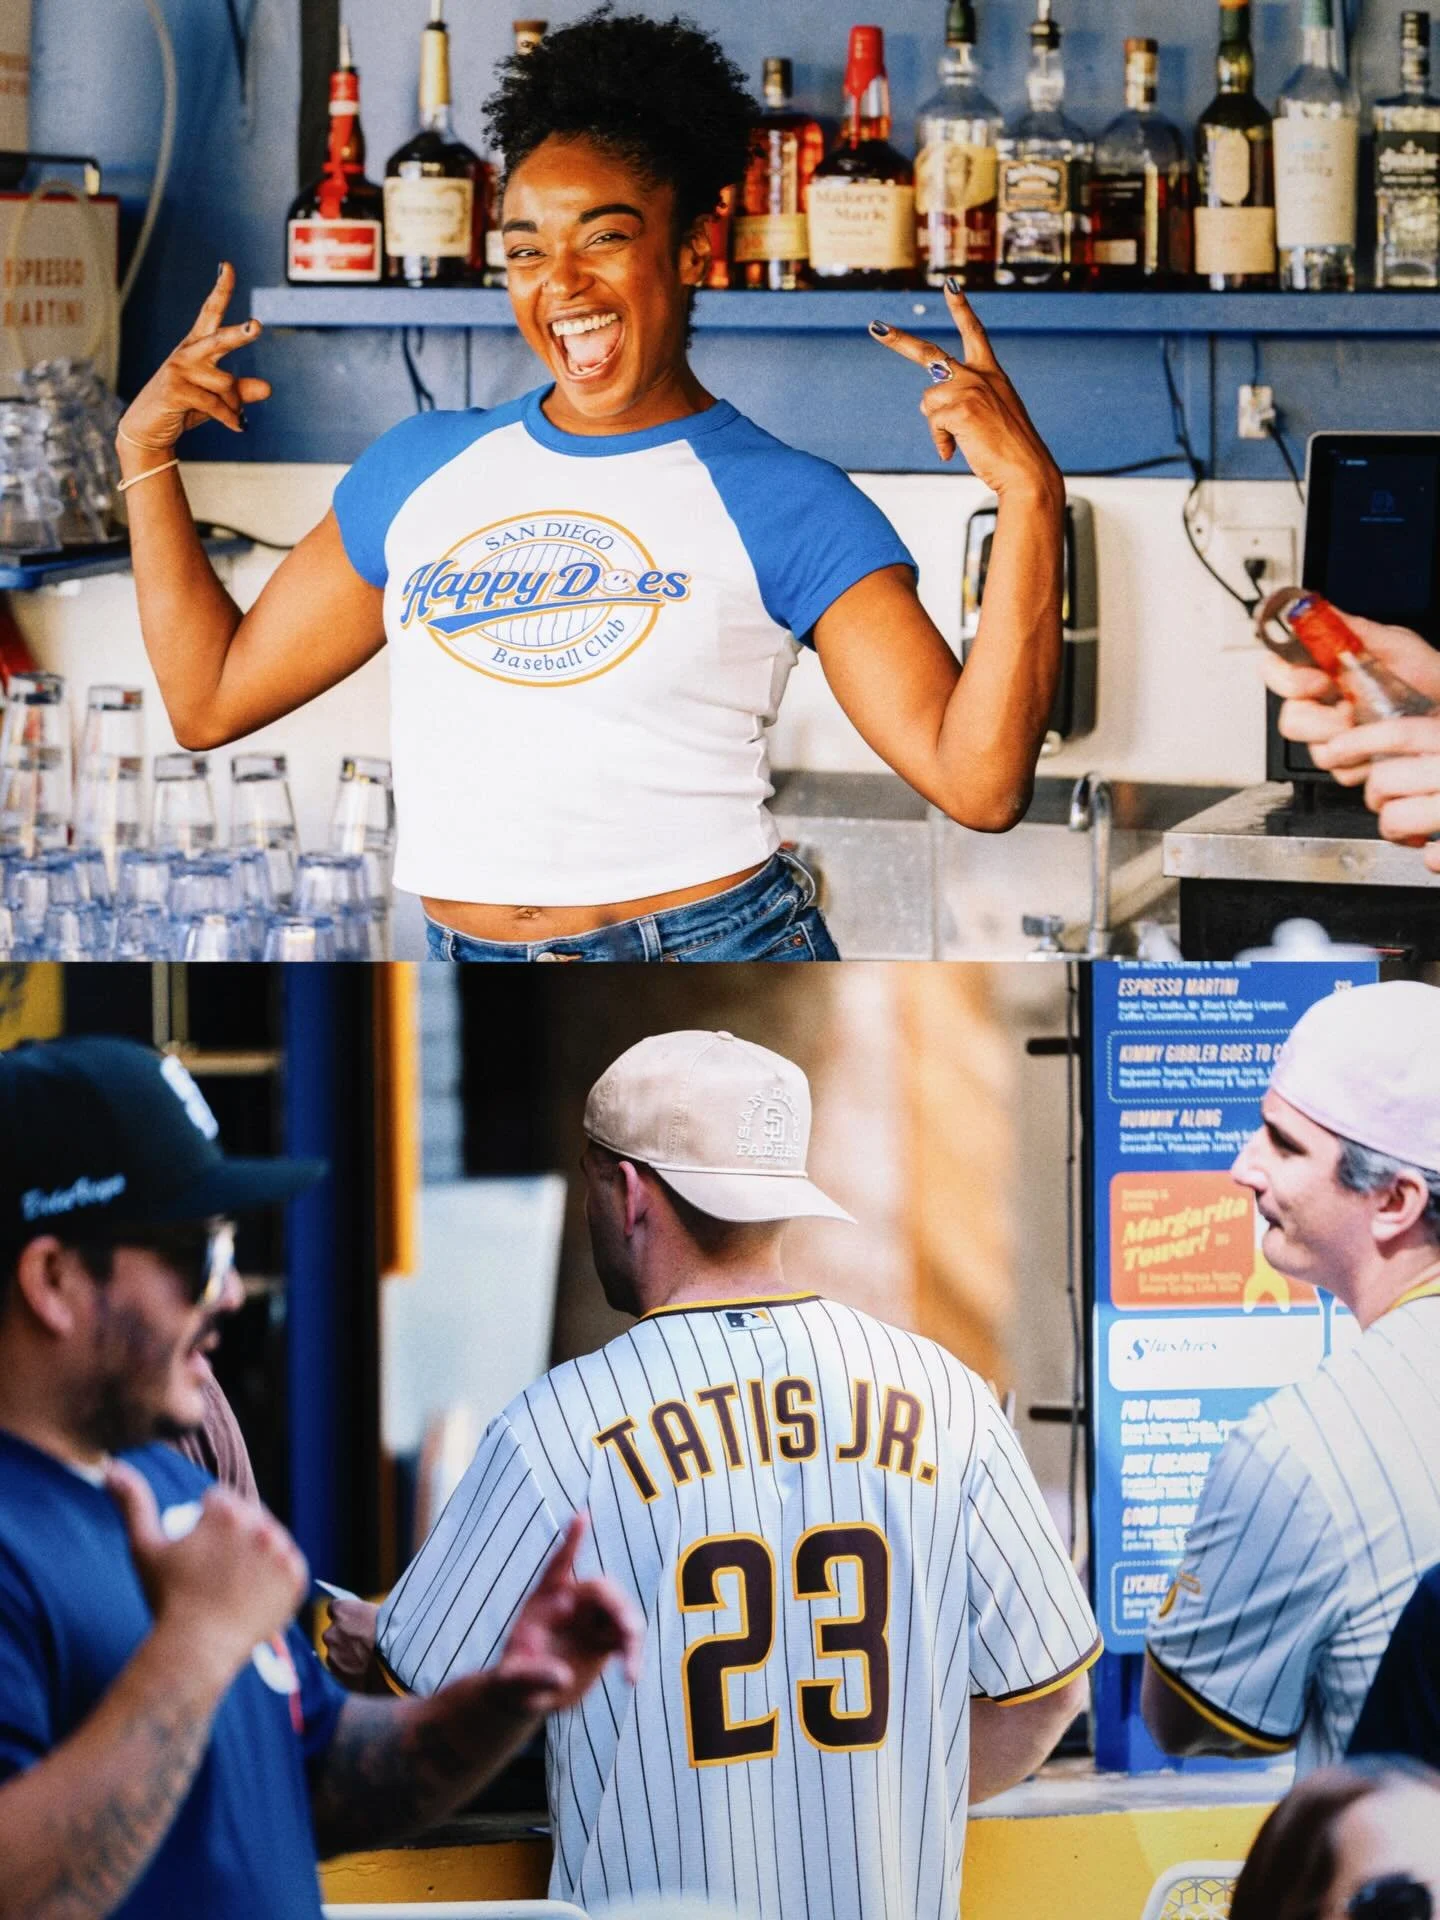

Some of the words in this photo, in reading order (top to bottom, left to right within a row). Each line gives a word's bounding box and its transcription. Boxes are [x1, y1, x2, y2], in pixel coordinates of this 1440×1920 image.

[815, 190, 890, 204] Maker's
[834, 206, 887, 222] Mark
[485, 524, 536, 551] SAN
[545, 522, 615, 551] DIEGO
[400, 558, 552, 629] Happy
[491, 647, 583, 672] Baseball
[584, 616, 626, 657] Club
[1118, 978, 1184, 997] ESPRESSO
[1184, 977, 1240, 996] MARTINI
[1119, 1045, 1164, 1063] KIMMY
[1219, 1044, 1253, 1062] GOES
[1256, 1044, 1271, 1062] TO
[736, 1142, 801, 1159] PADRES
[1121, 1196, 1248, 1245] Margarita
[1127, 1339, 1217, 1360] Slushies
[592, 1375, 819, 1504] TATIS
[835, 1377, 938, 1486] JR.
[675, 1521, 893, 1768] 23
